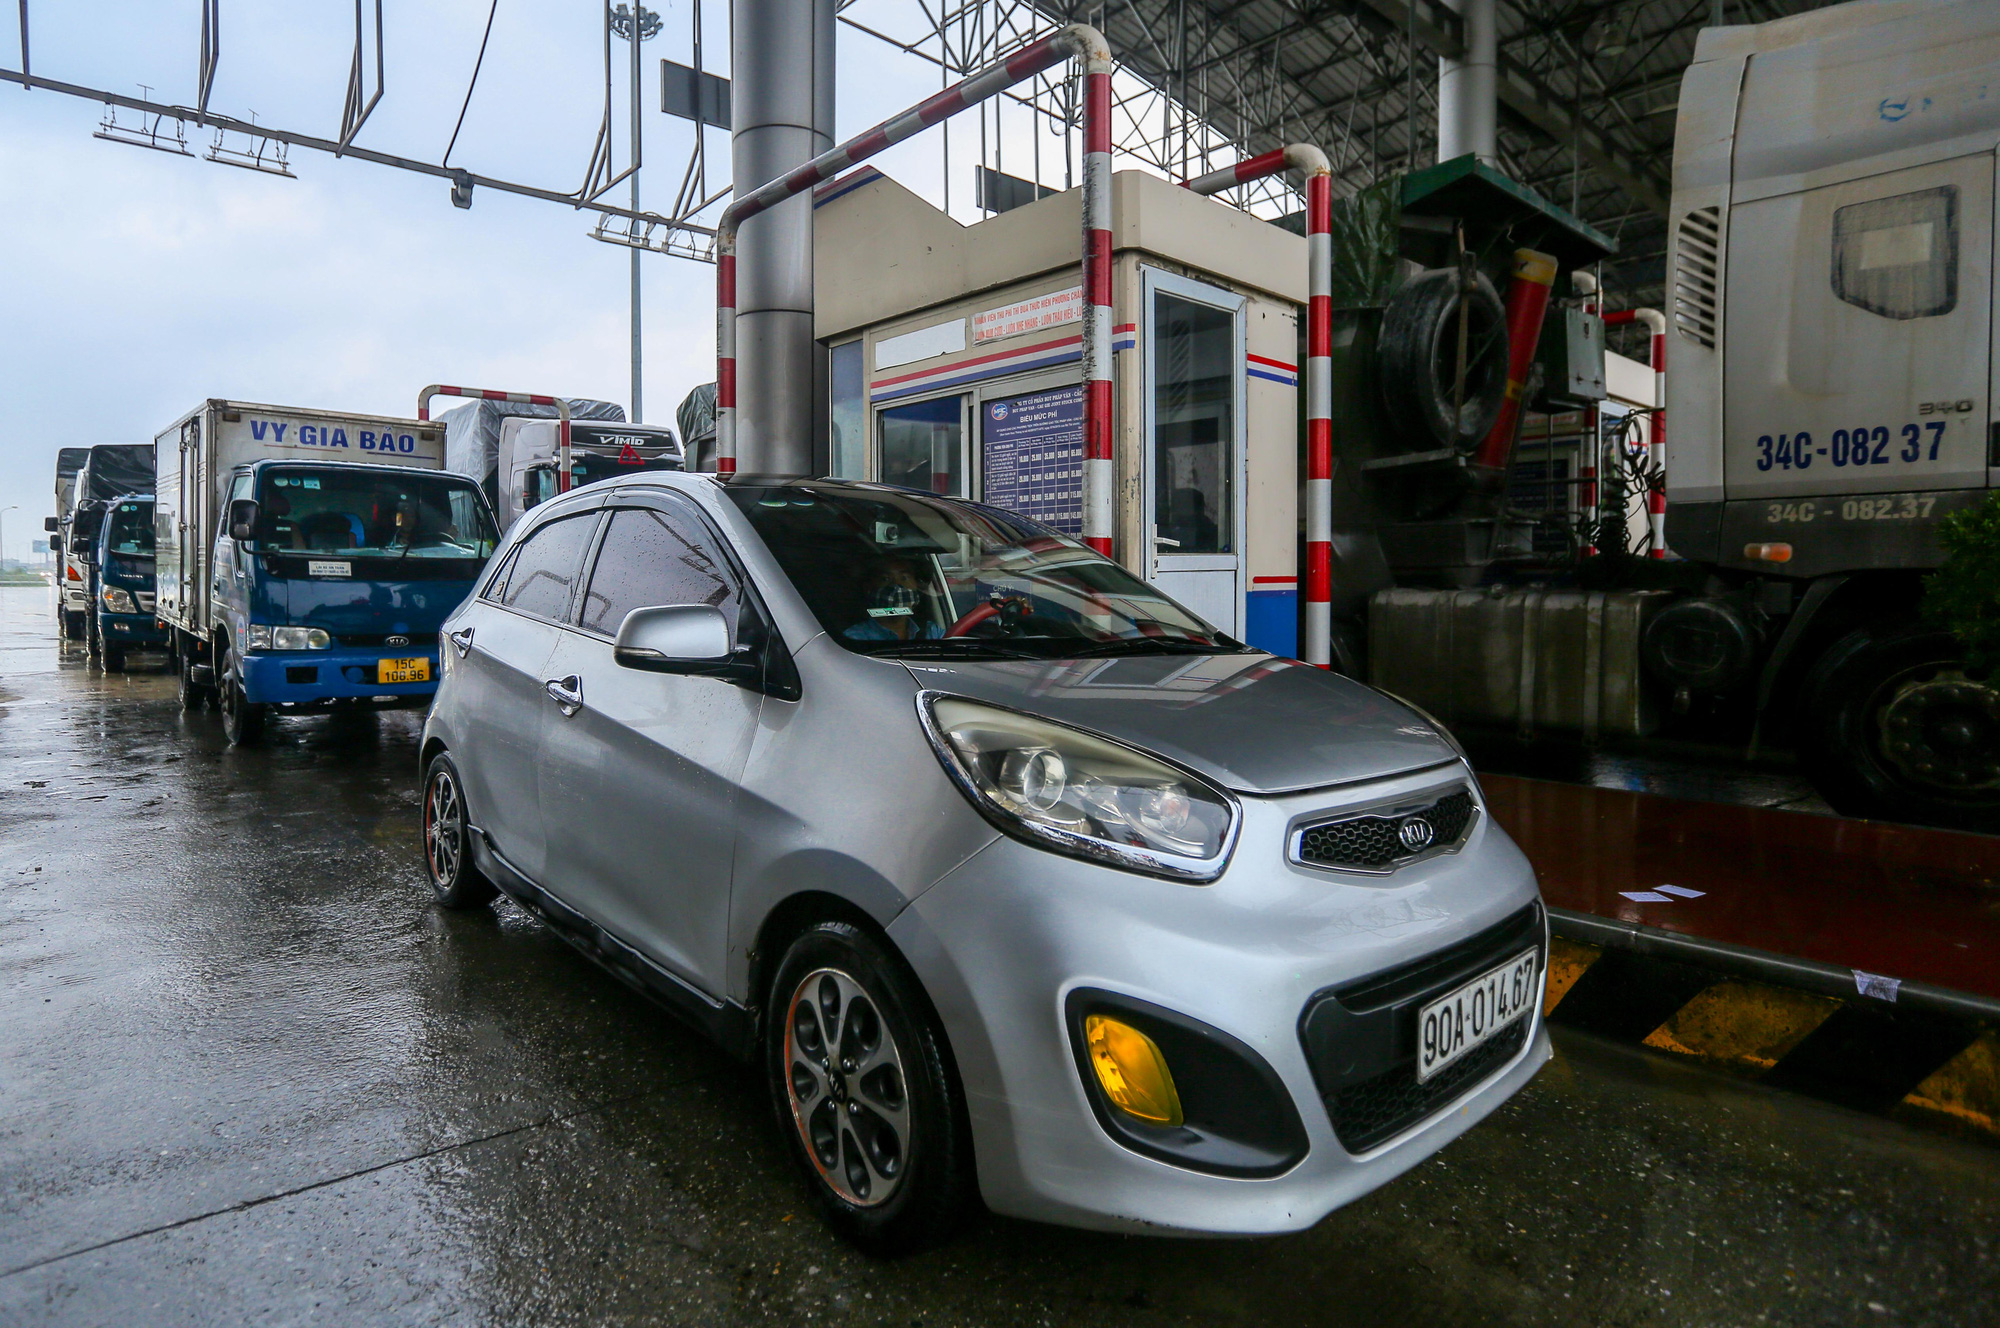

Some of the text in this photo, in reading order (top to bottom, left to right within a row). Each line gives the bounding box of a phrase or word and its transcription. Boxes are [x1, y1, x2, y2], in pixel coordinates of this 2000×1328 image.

[1048, 410, 1057, 418] PHÍ
[250, 420, 414, 453] VY GIA BẢO
[1767, 501, 1816, 523] 34C
[1842, 498, 1936, 520] 082.37
[395, 659, 415, 669] 15C
[1404, 823, 1428, 843] KIA
[1424, 956, 1534, 1067] 90A-014.67
[829, 1073, 843, 1099] KIA
